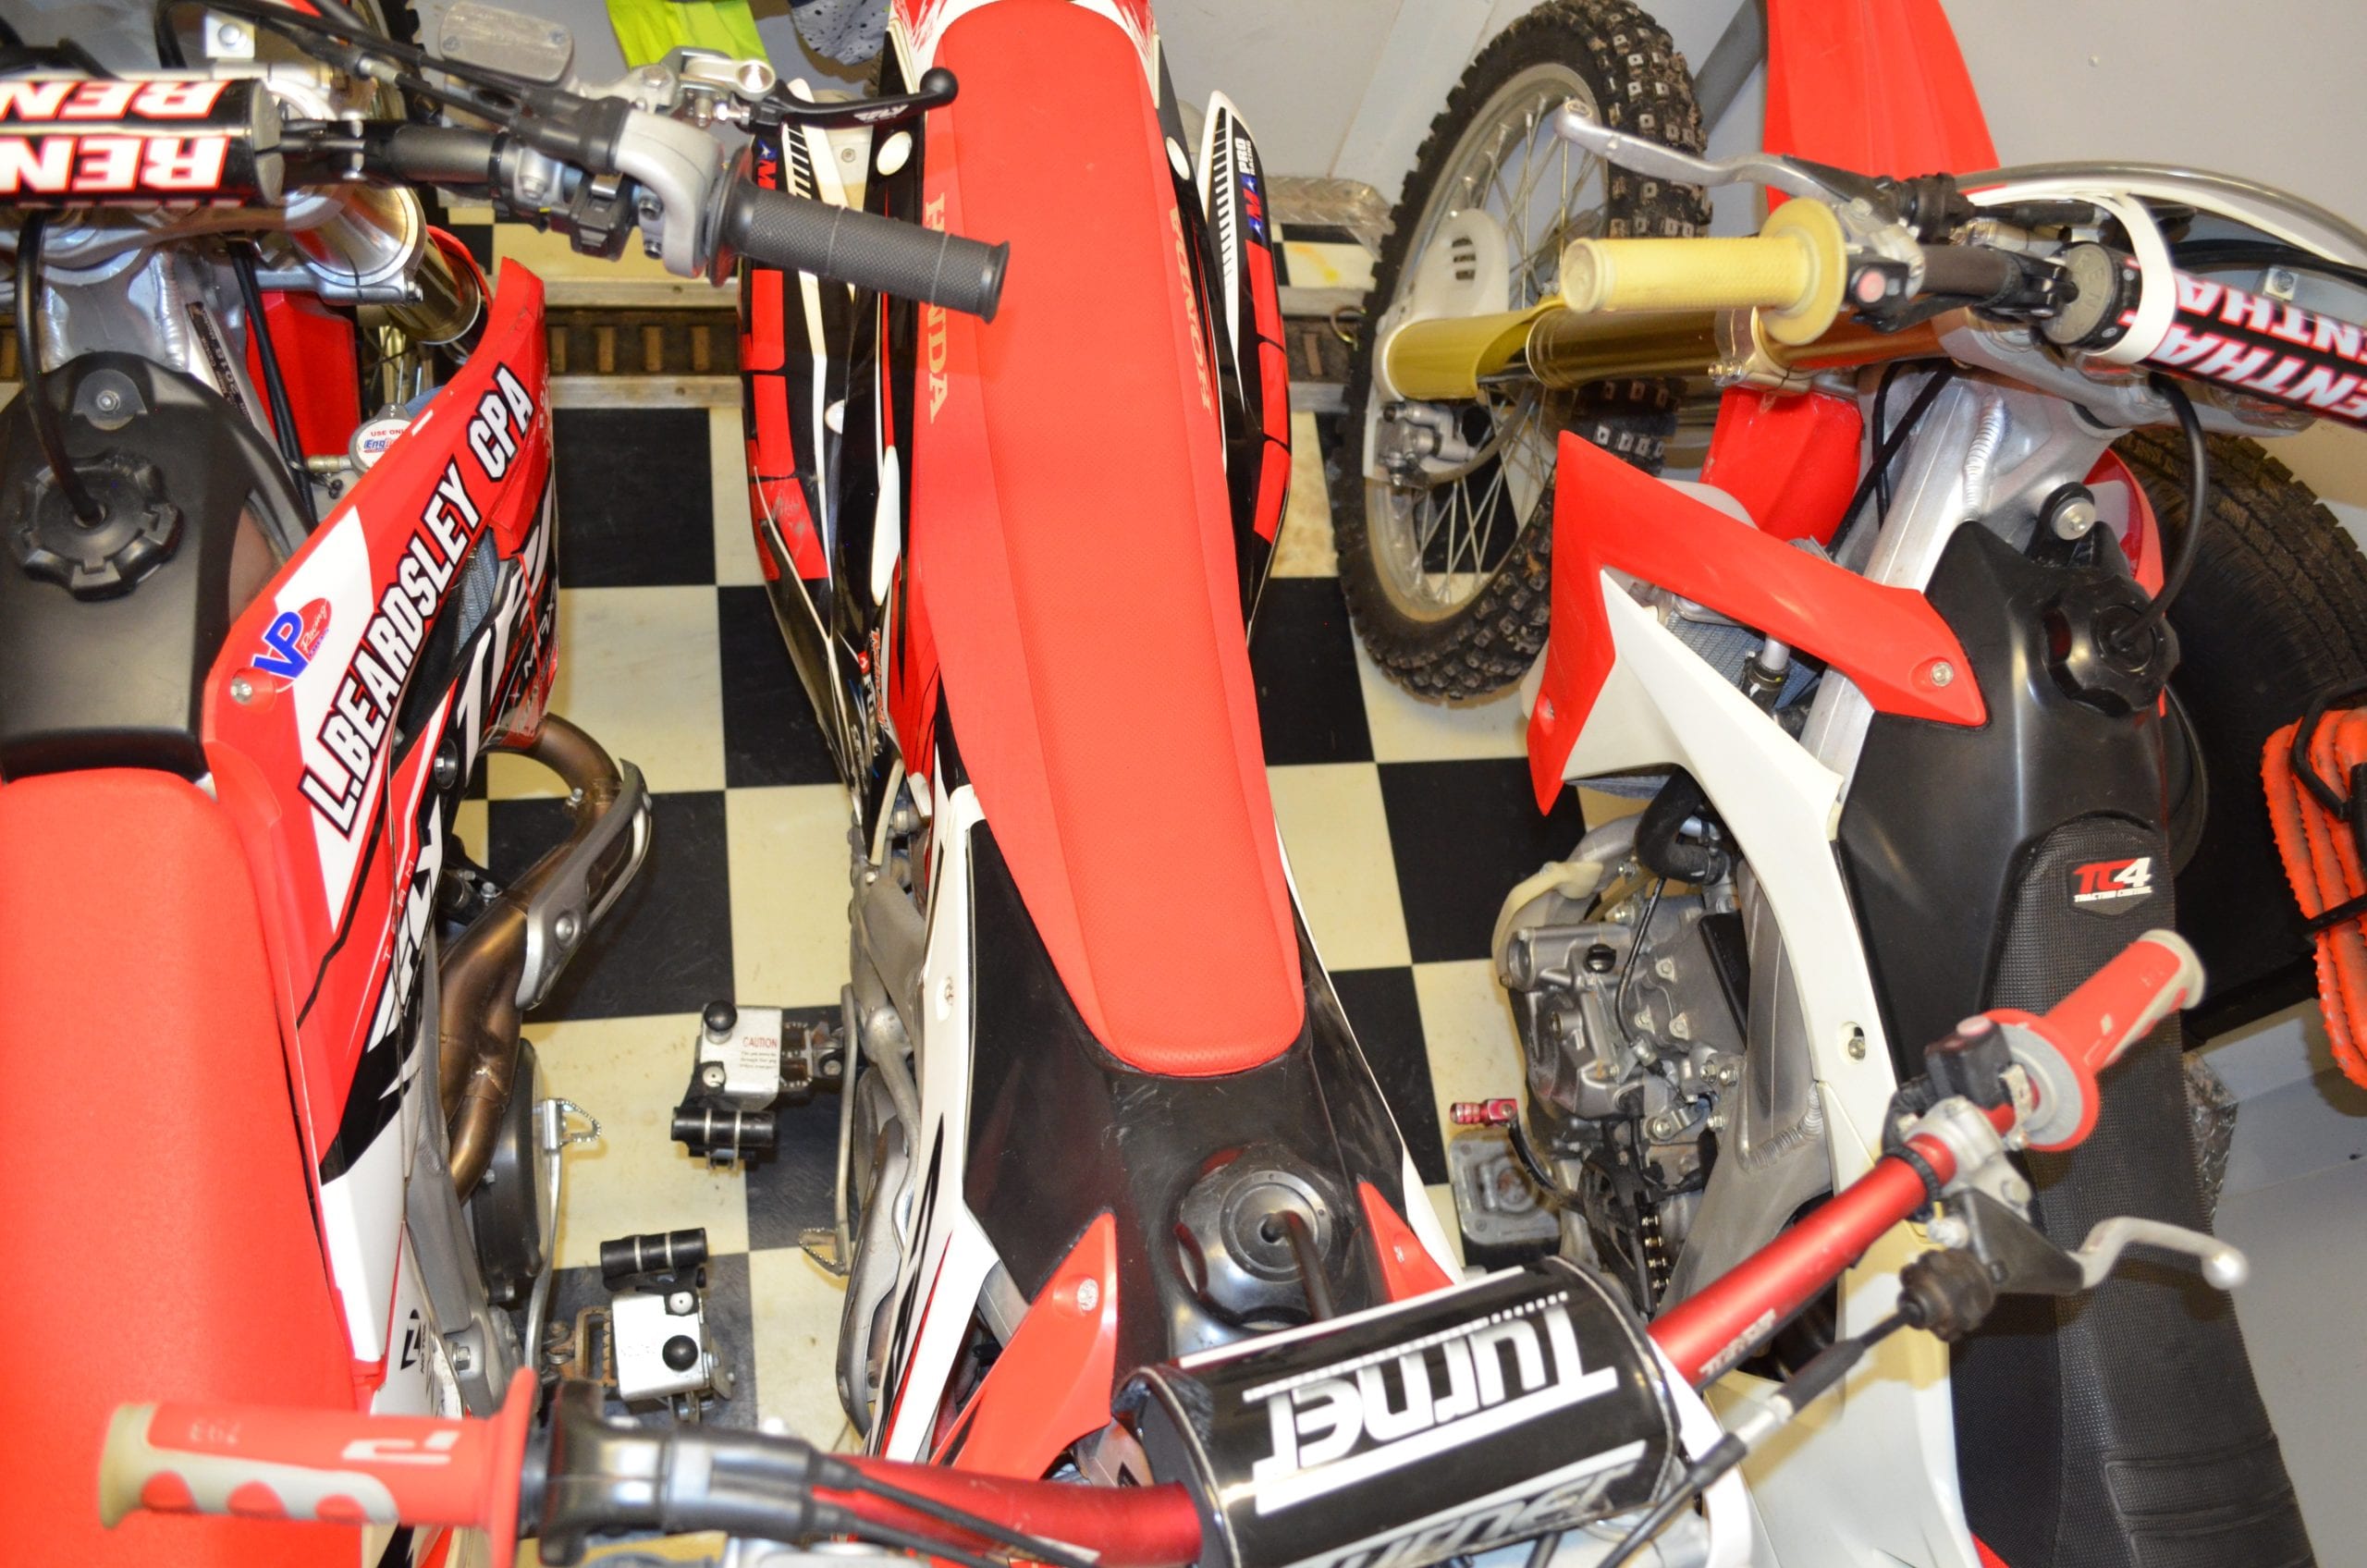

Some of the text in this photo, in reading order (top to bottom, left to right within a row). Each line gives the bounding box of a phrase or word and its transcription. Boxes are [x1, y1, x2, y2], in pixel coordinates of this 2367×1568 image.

[1235, 137, 1250, 174] PRO
[1245, 139, 1257, 176] RACING
[1240, 174, 1264, 240] AMA
[925, 192, 949, 424] HNDA
[1169, 204, 1213, 415] HONDA
[300, 455, 480, 839] L.BEARDSLEY
[466, 362, 534, 482] CPA
[300, 600, 330, 655] Racing
[250, 610, 310, 681] VP
[2073, 856, 2152, 894] TC4
[382, 858, 414, 962] TEAM
[742, 1035, 778, 1048] CAUTION
[1252, 1299, 1618, 1514] Turner
